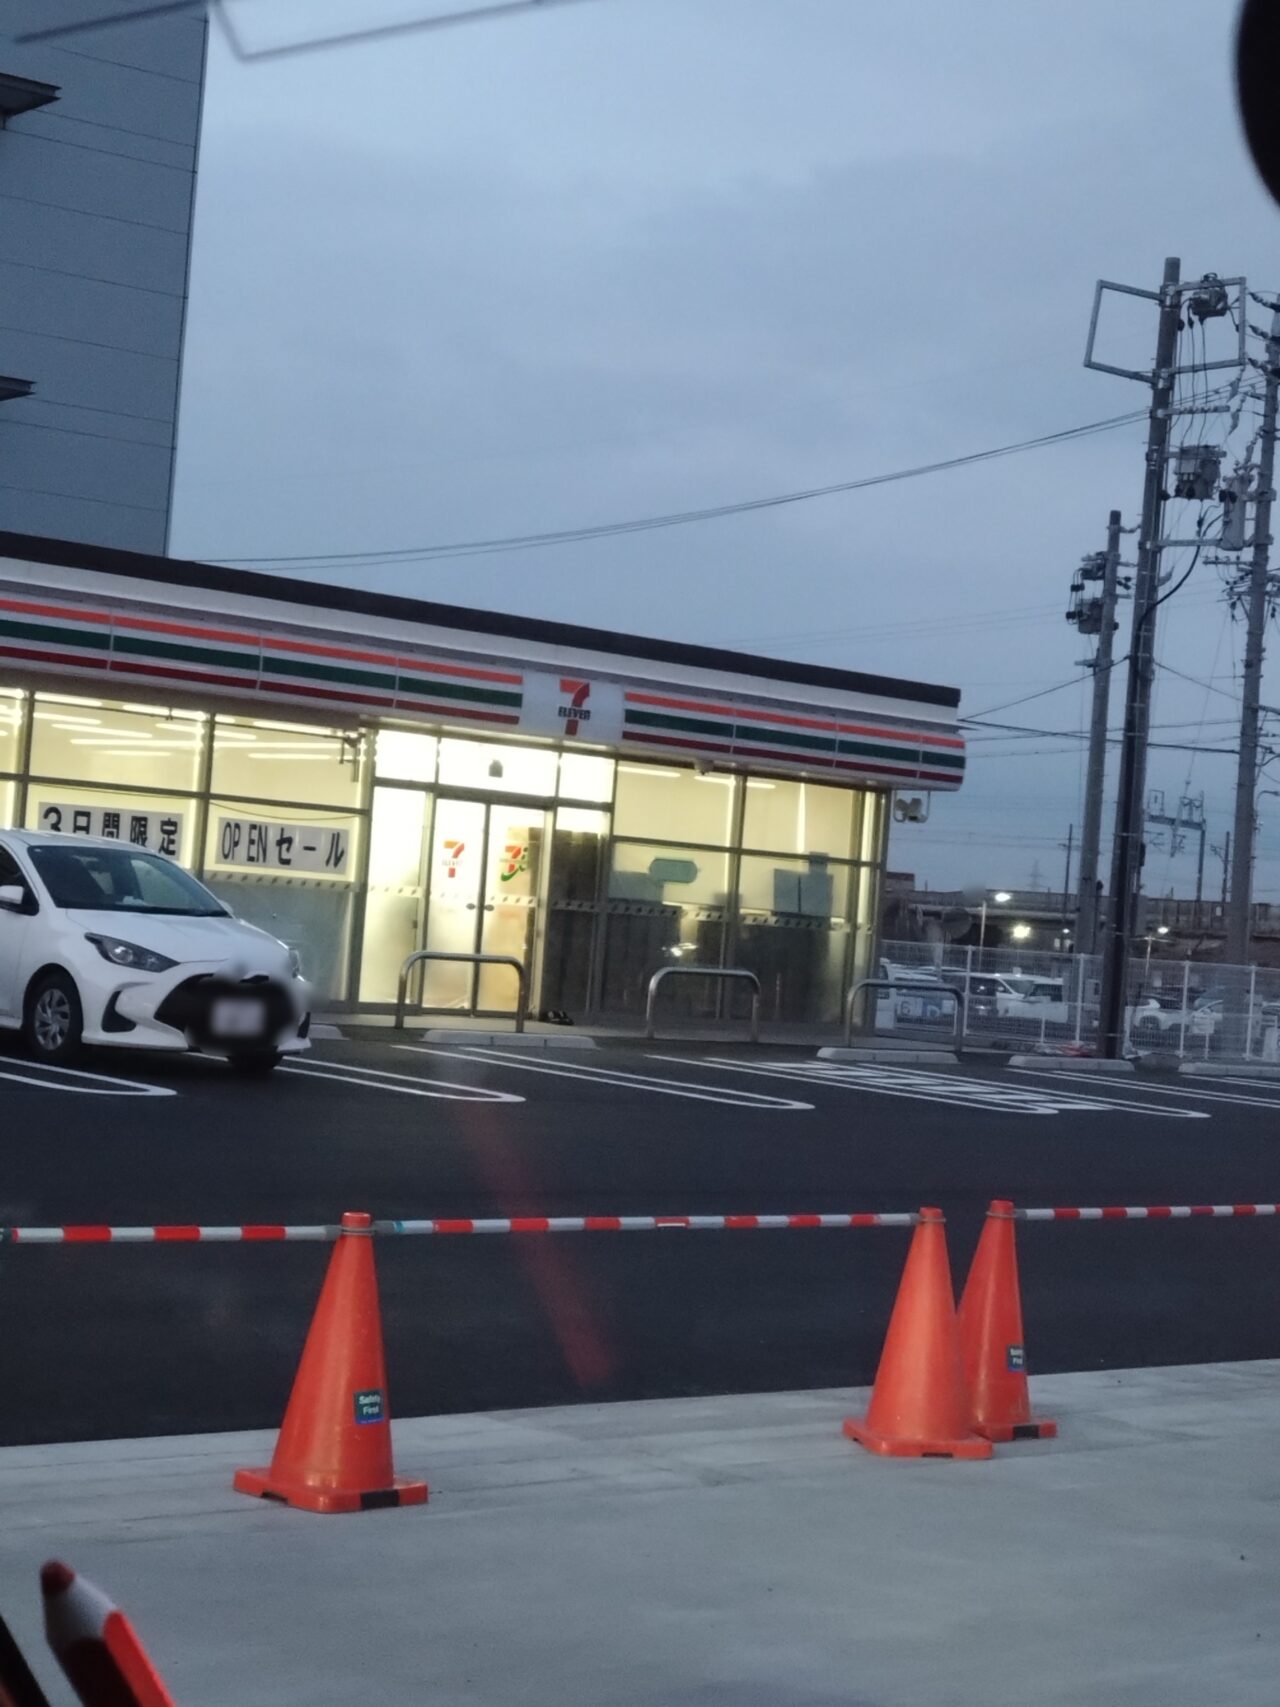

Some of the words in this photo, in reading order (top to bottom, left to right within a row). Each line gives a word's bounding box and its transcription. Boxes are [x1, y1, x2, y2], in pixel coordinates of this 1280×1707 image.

[559, 678, 590, 736] 7
[43, 806, 178, 856] 3日間限定
